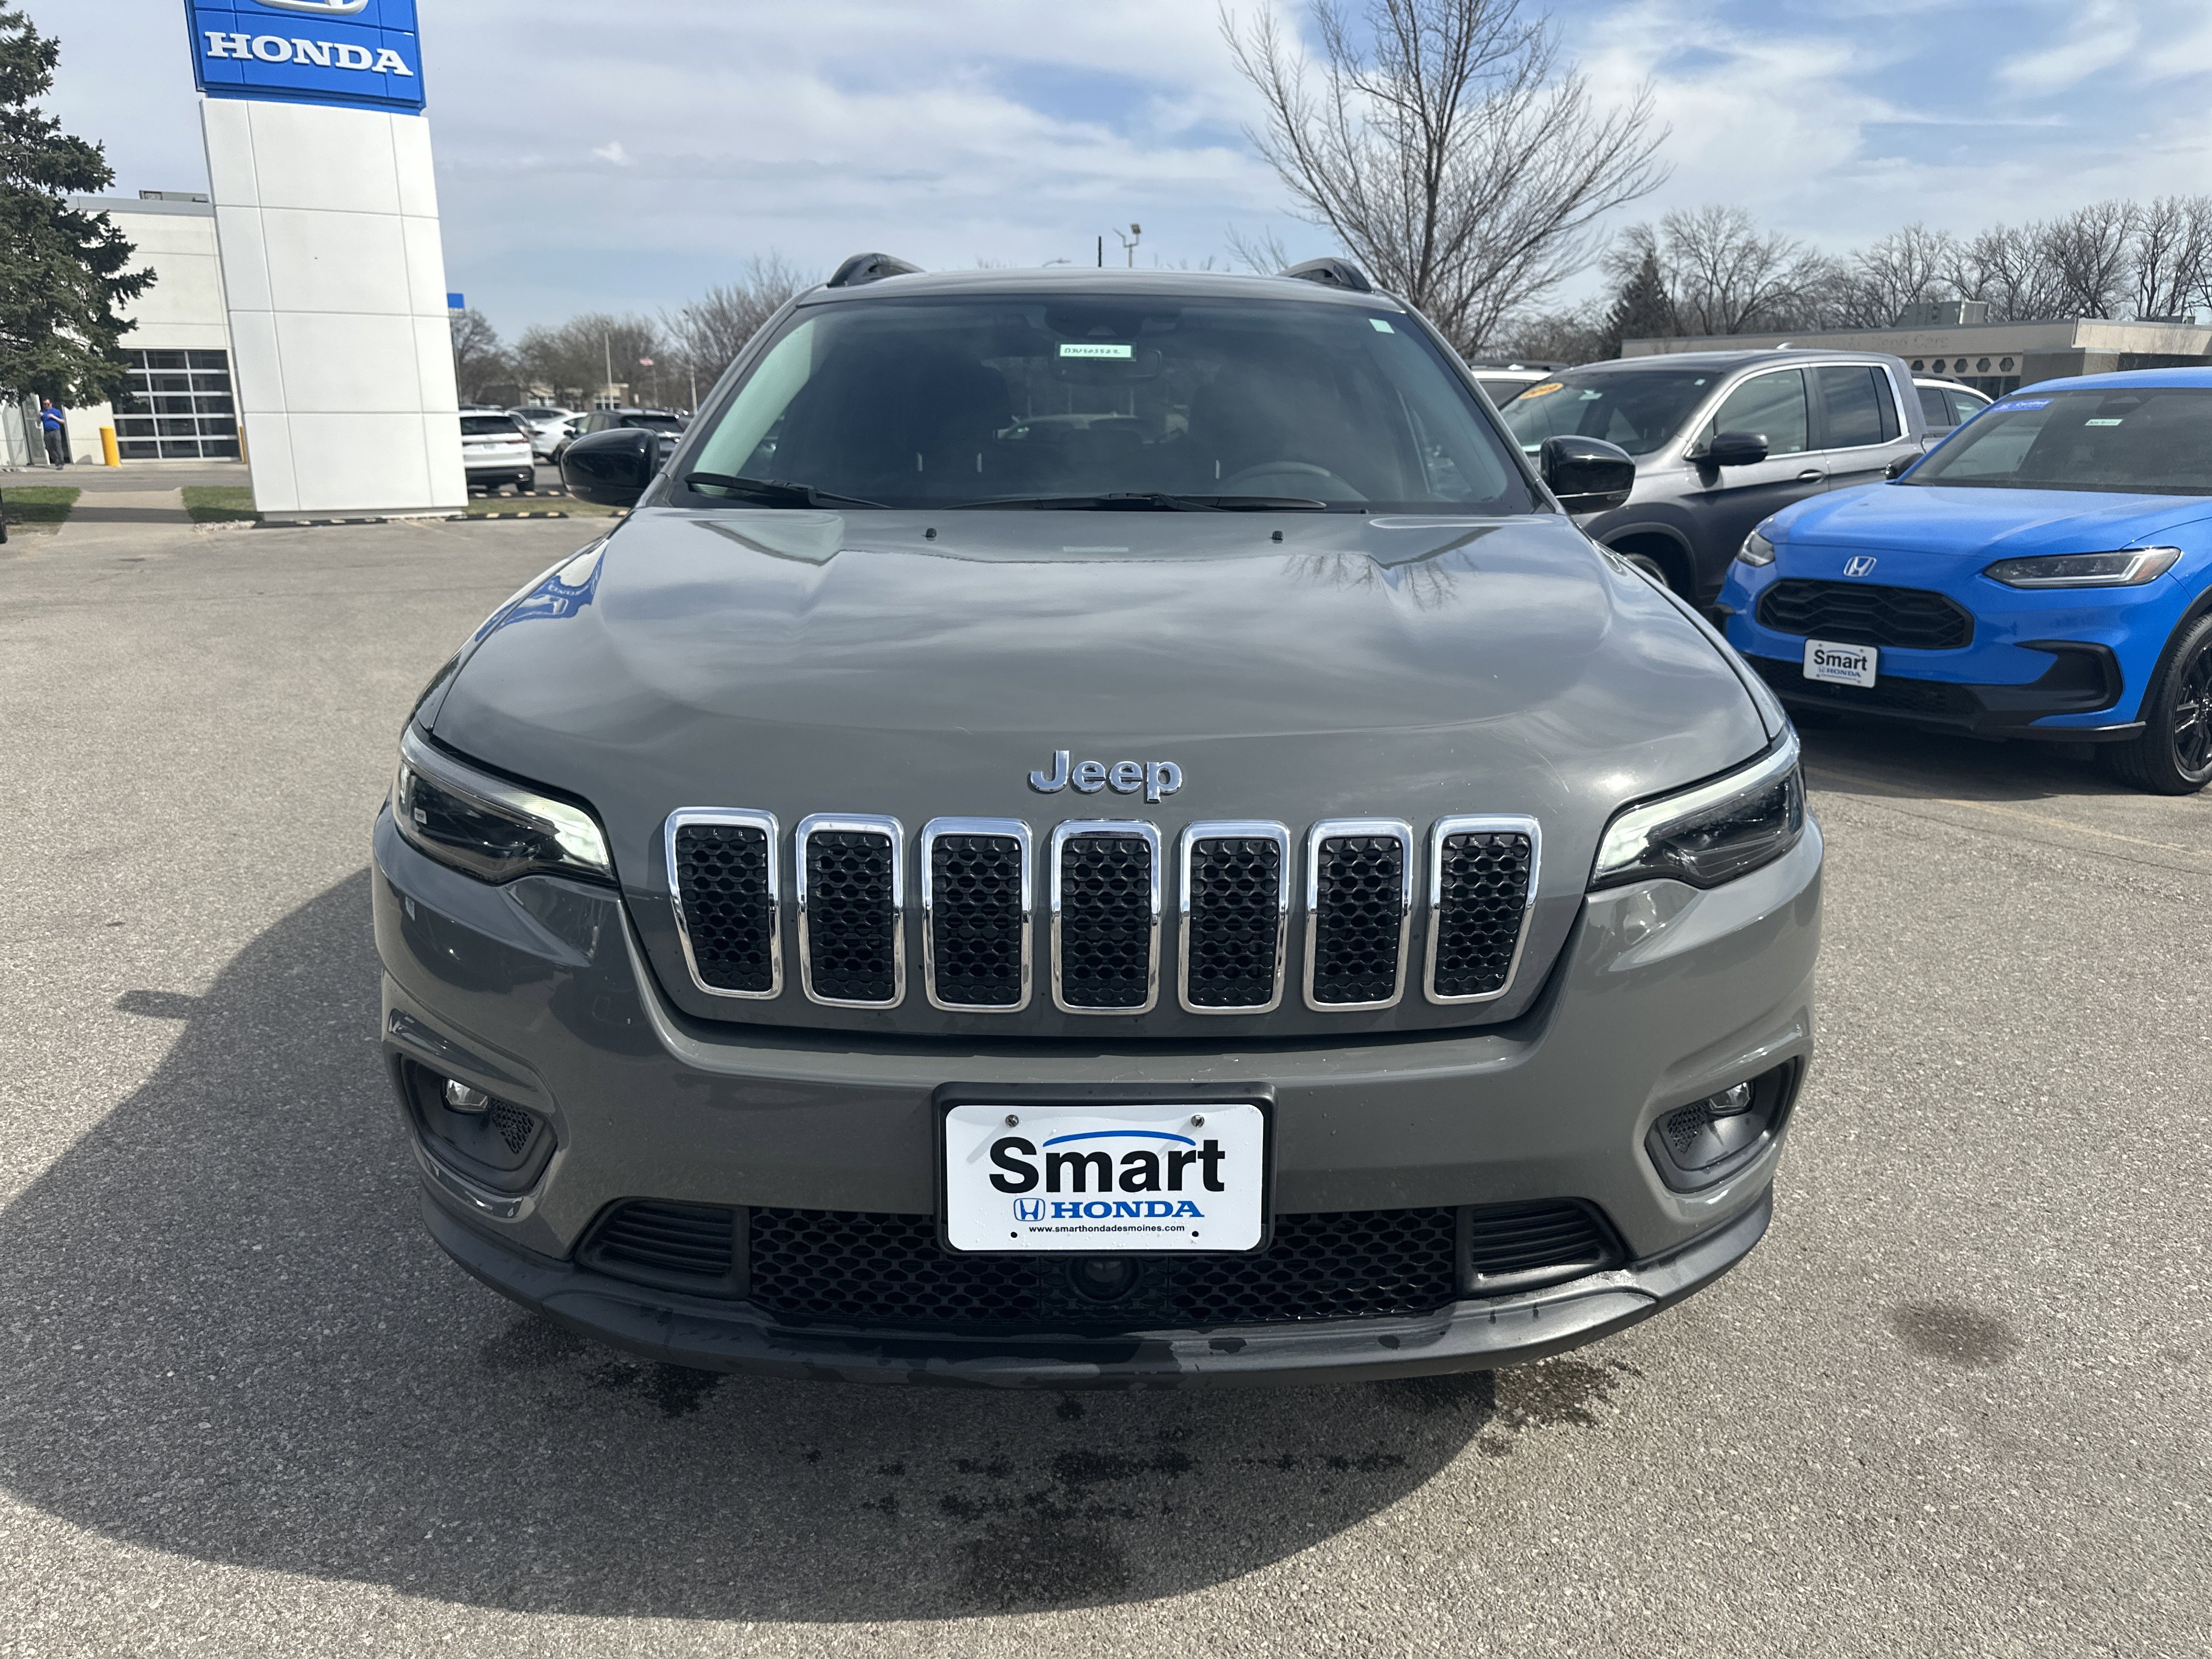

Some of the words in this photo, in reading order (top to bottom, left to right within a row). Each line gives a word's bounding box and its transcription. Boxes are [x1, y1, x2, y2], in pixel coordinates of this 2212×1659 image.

[205, 31, 414, 77] HONDA
[1813, 649, 1867, 671] Smart
[1826, 668, 1861, 678] HONDA
[1029, 749, 1183, 803] Jeep
[989, 1136, 1225, 1194] Smart
[1051, 1200, 1205, 1219] HONDA
[1029, 1224, 1185, 1233] www.smarthondadesmoines.com
